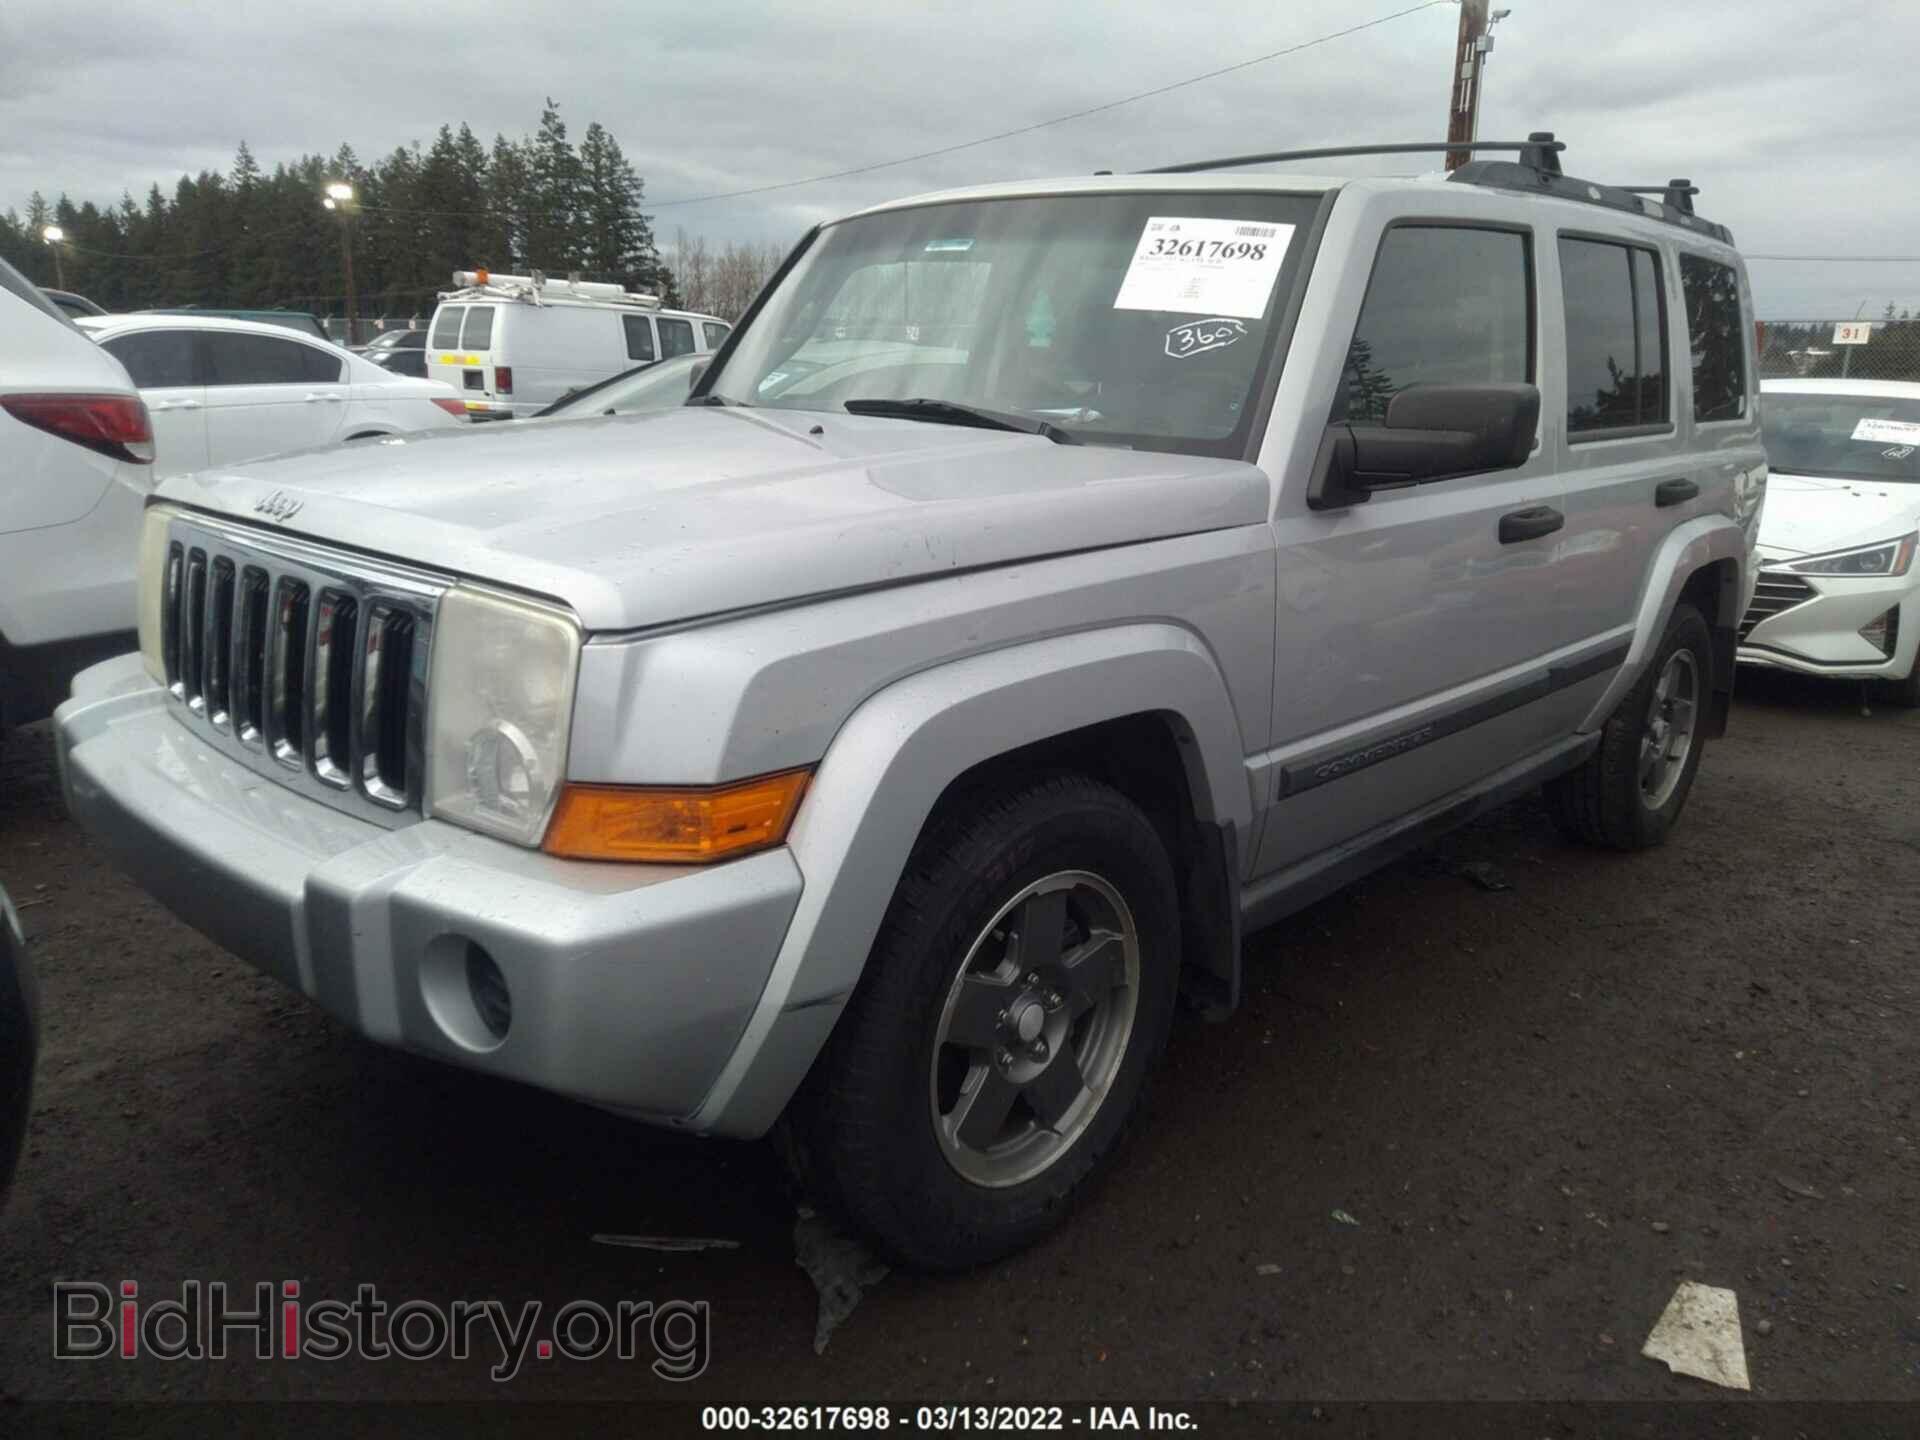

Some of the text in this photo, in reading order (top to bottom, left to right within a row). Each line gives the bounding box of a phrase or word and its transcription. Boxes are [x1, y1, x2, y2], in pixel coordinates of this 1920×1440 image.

[1149, 238, 1267, 261] 32617698
[1841, 328, 1860, 340] 31
[254, 490, 304, 522] Jeep
